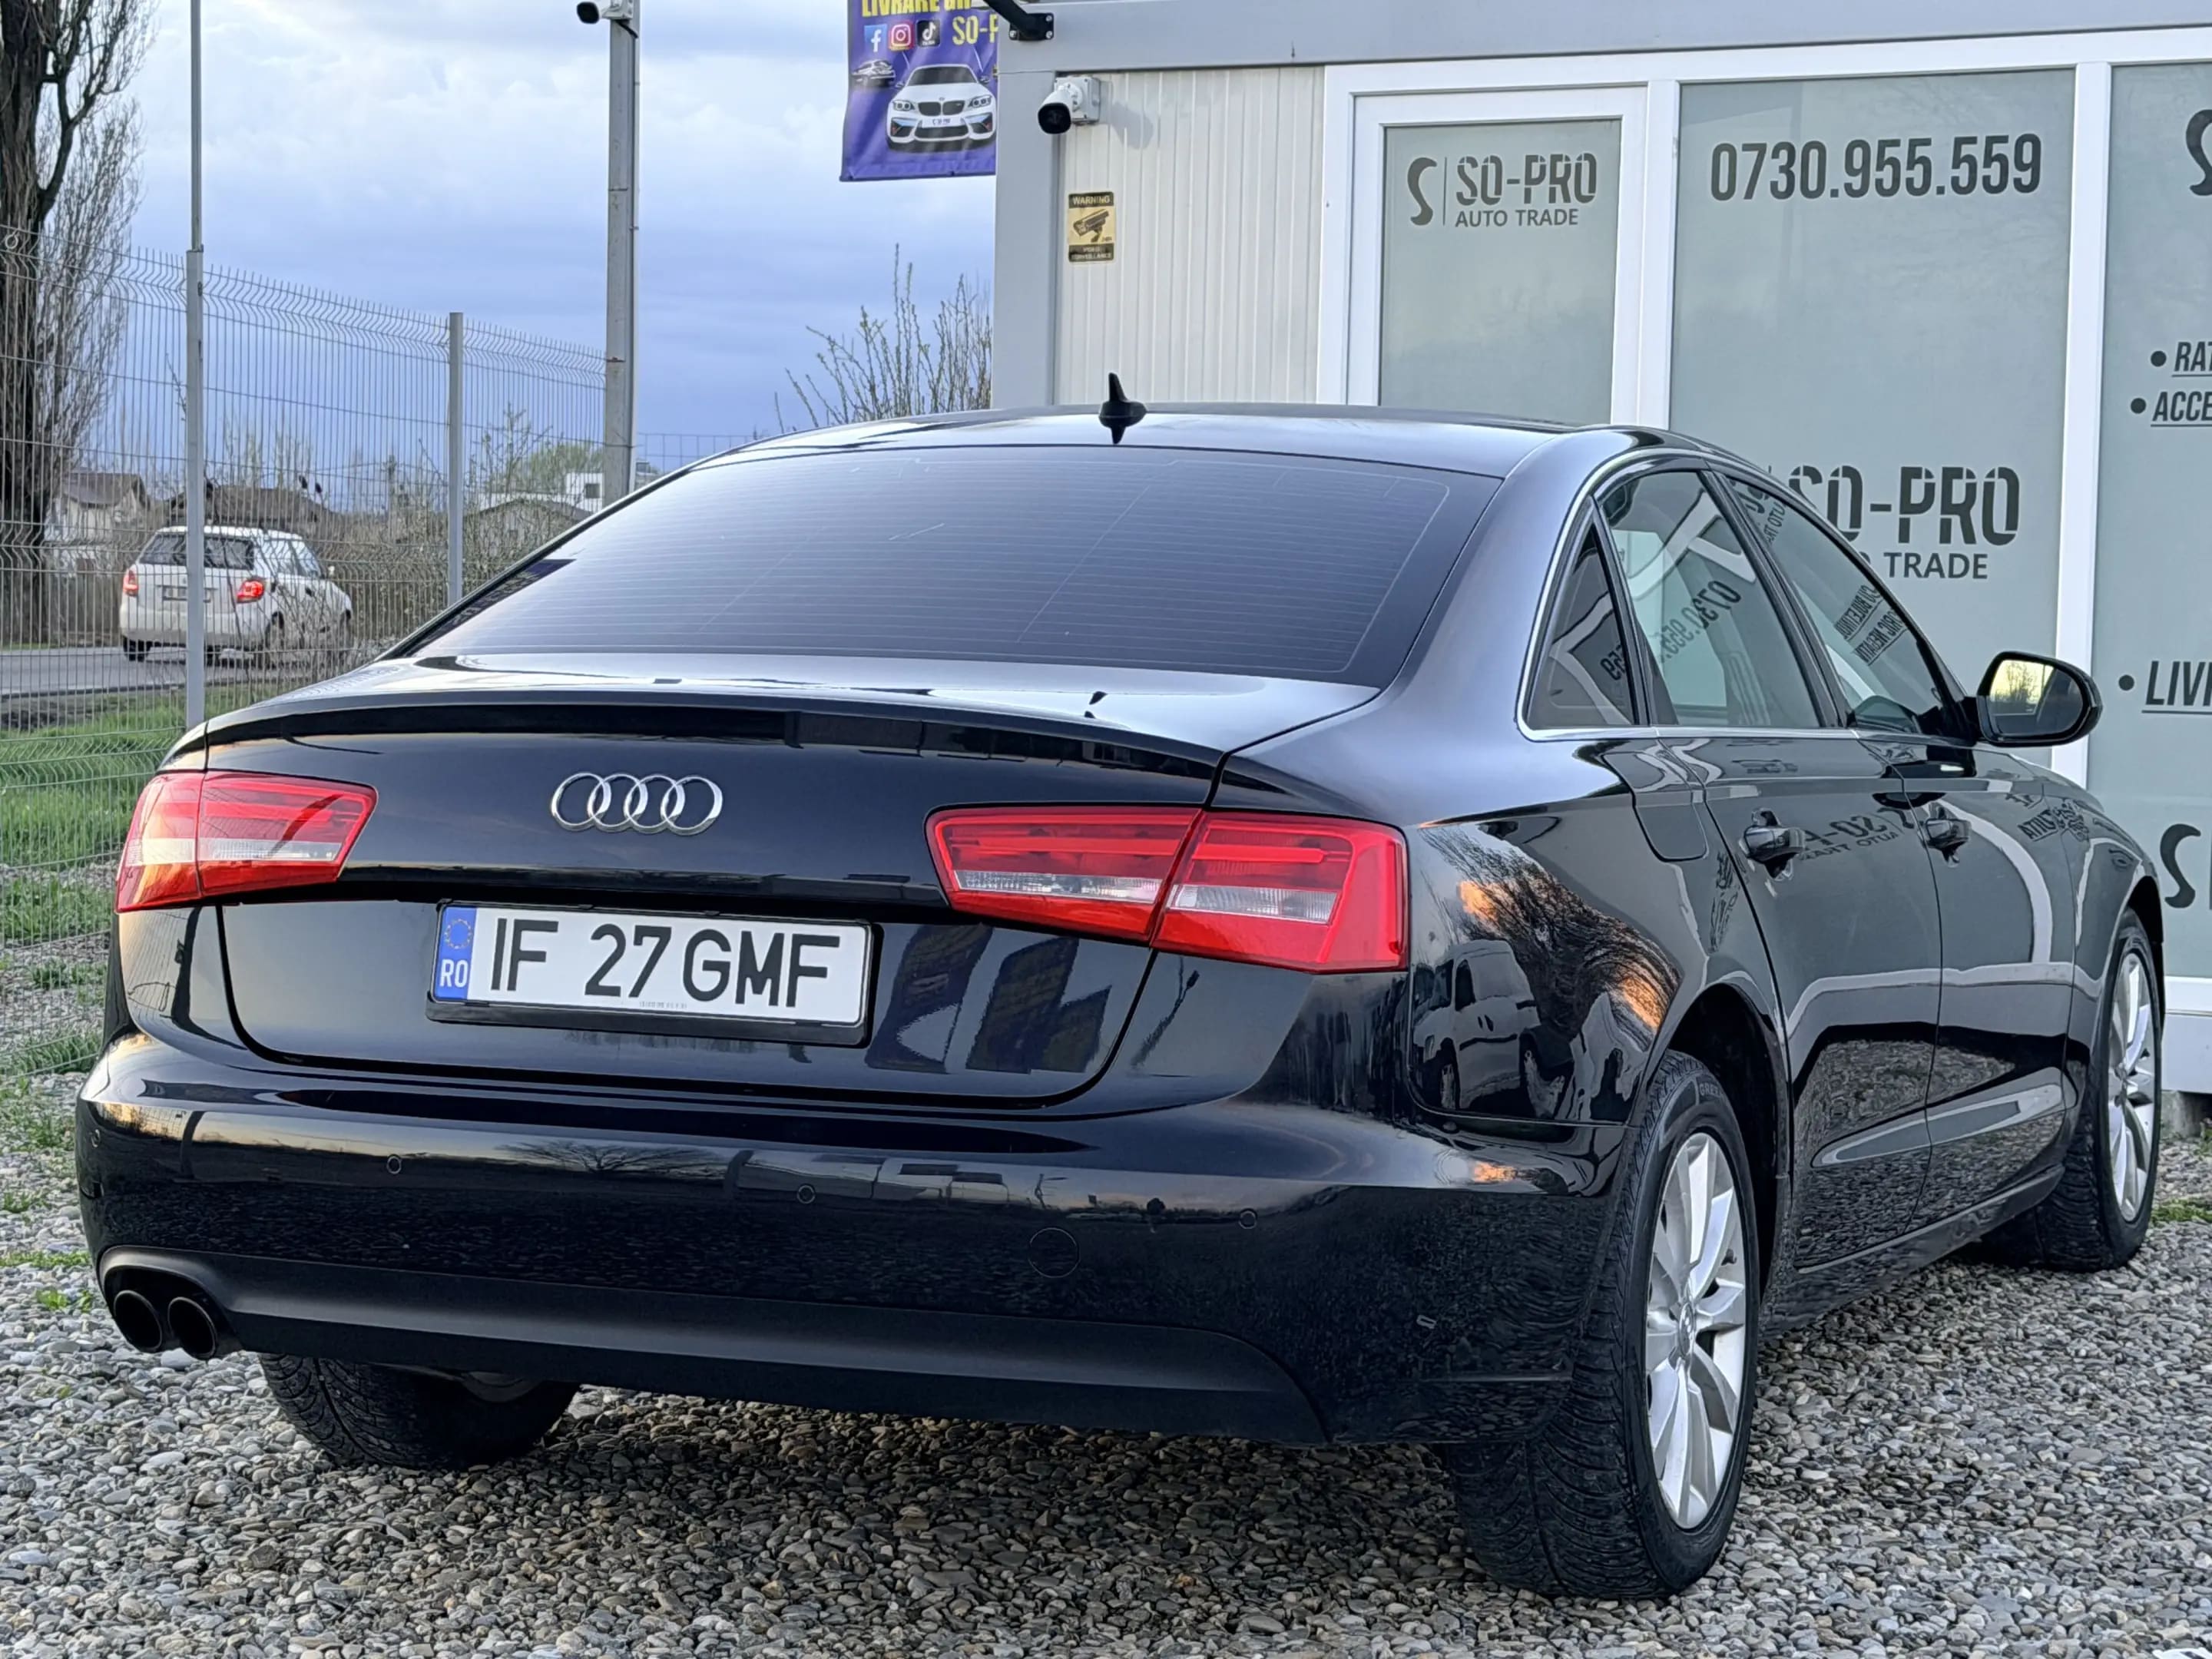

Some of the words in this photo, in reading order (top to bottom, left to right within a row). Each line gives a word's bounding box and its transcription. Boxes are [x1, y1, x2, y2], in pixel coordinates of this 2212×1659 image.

[1456, 153, 1598, 206] SO-PRO
[1710, 133, 2042, 201] 0730.955.559
[1455, 210, 1508, 227] AUTO
[1515, 208, 1579, 227] TRADE
[1883, 552, 1988, 579] TRADE
[439, 959, 469, 988] RO
[490, 917, 559, 992] IF
[584, 923, 672, 998] 27
[682, 928, 841, 1008] GMF
